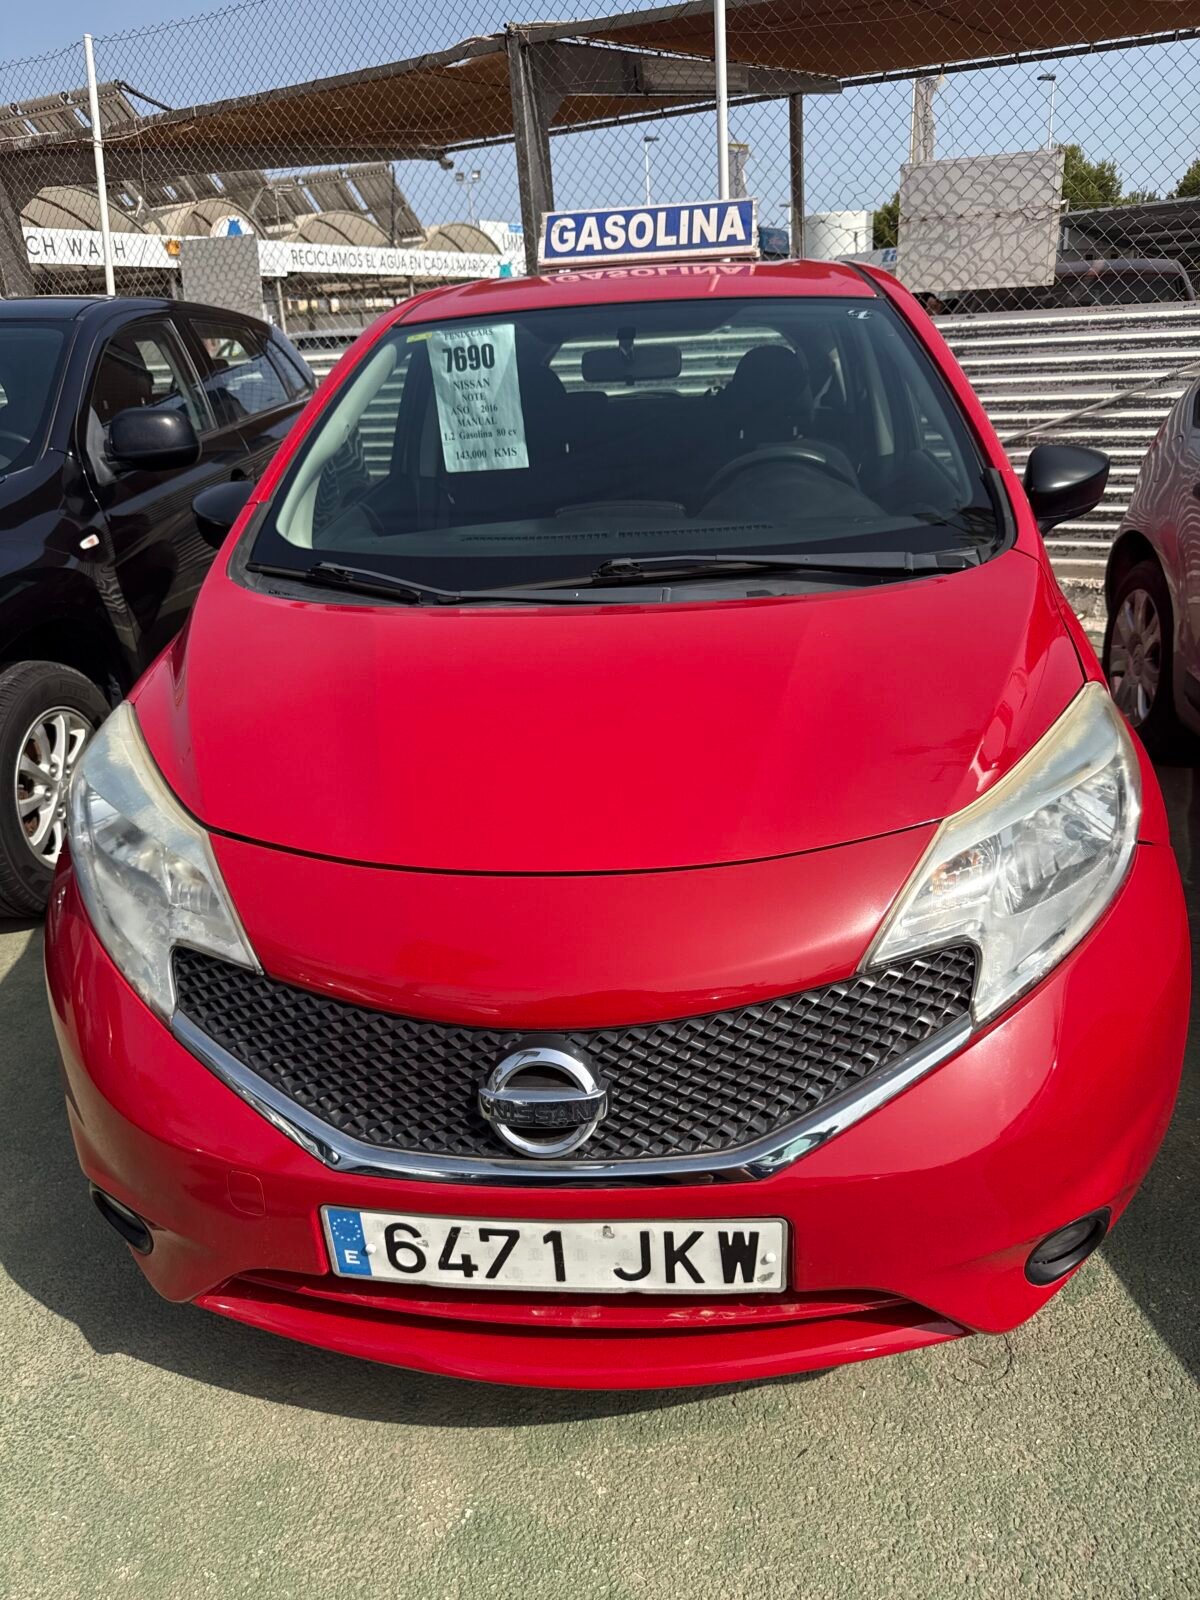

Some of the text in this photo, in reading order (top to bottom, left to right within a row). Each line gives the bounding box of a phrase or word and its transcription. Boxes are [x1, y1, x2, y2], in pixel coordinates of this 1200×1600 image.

[550, 206, 746, 252] GASOLINA
[66, 237, 126, 258] WAH
[290, 249, 364, 268] RECICLAMOS
[366, 253, 376, 269] EL
[379, 252, 406, 271] AGUA
[409, 255, 421, 271] EN
[442, 343, 495, 373] 7690
[453, 378, 490, 391] NISSAN
[462, 392, 486, 402] NOTE
[451, 404, 498, 416] AÑO 2016
[457, 417, 497, 427] MANUAL
[444, 433, 456, 441] 1.2
[459, 430, 493, 440] Gasolina
[496, 428, 506, 437] 80
[494, 448, 518, 458] KMS
[489, 1100, 593, 1124] NISSAN
[344, 1249, 361, 1265] E
[384, 1222, 759, 1285] 6471 JKW
